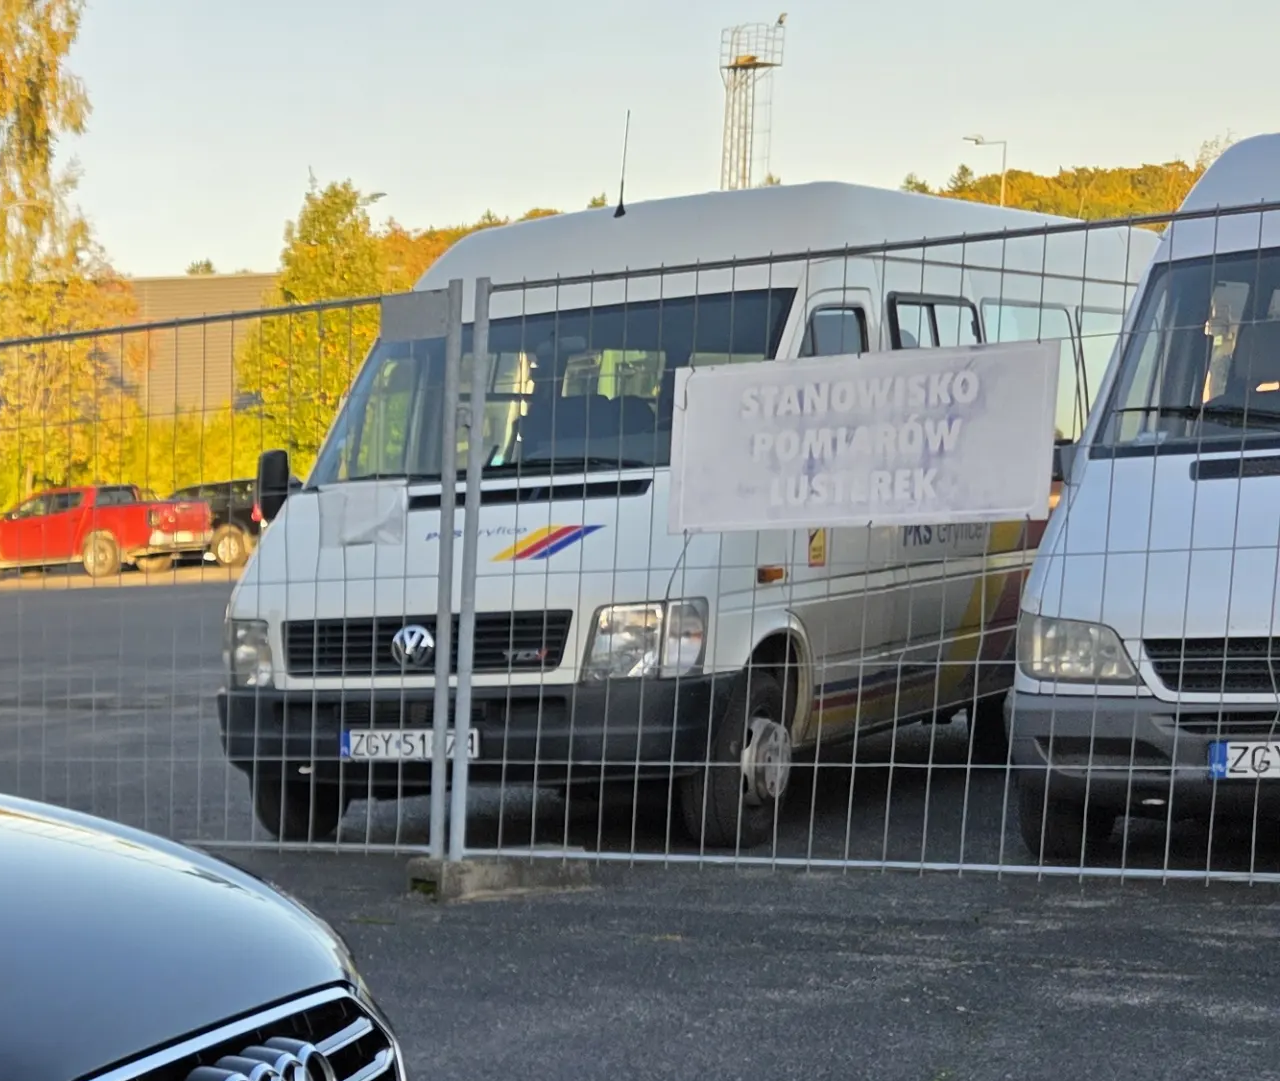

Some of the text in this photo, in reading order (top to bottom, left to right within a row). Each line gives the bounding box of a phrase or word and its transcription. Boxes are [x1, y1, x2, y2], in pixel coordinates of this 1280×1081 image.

[741, 370, 980, 419] STANOWISKO
[752, 413, 962, 463] POMIARÓW
[352, 733, 392, 757] ZGY
[1228, 745, 1280, 774] ZG
